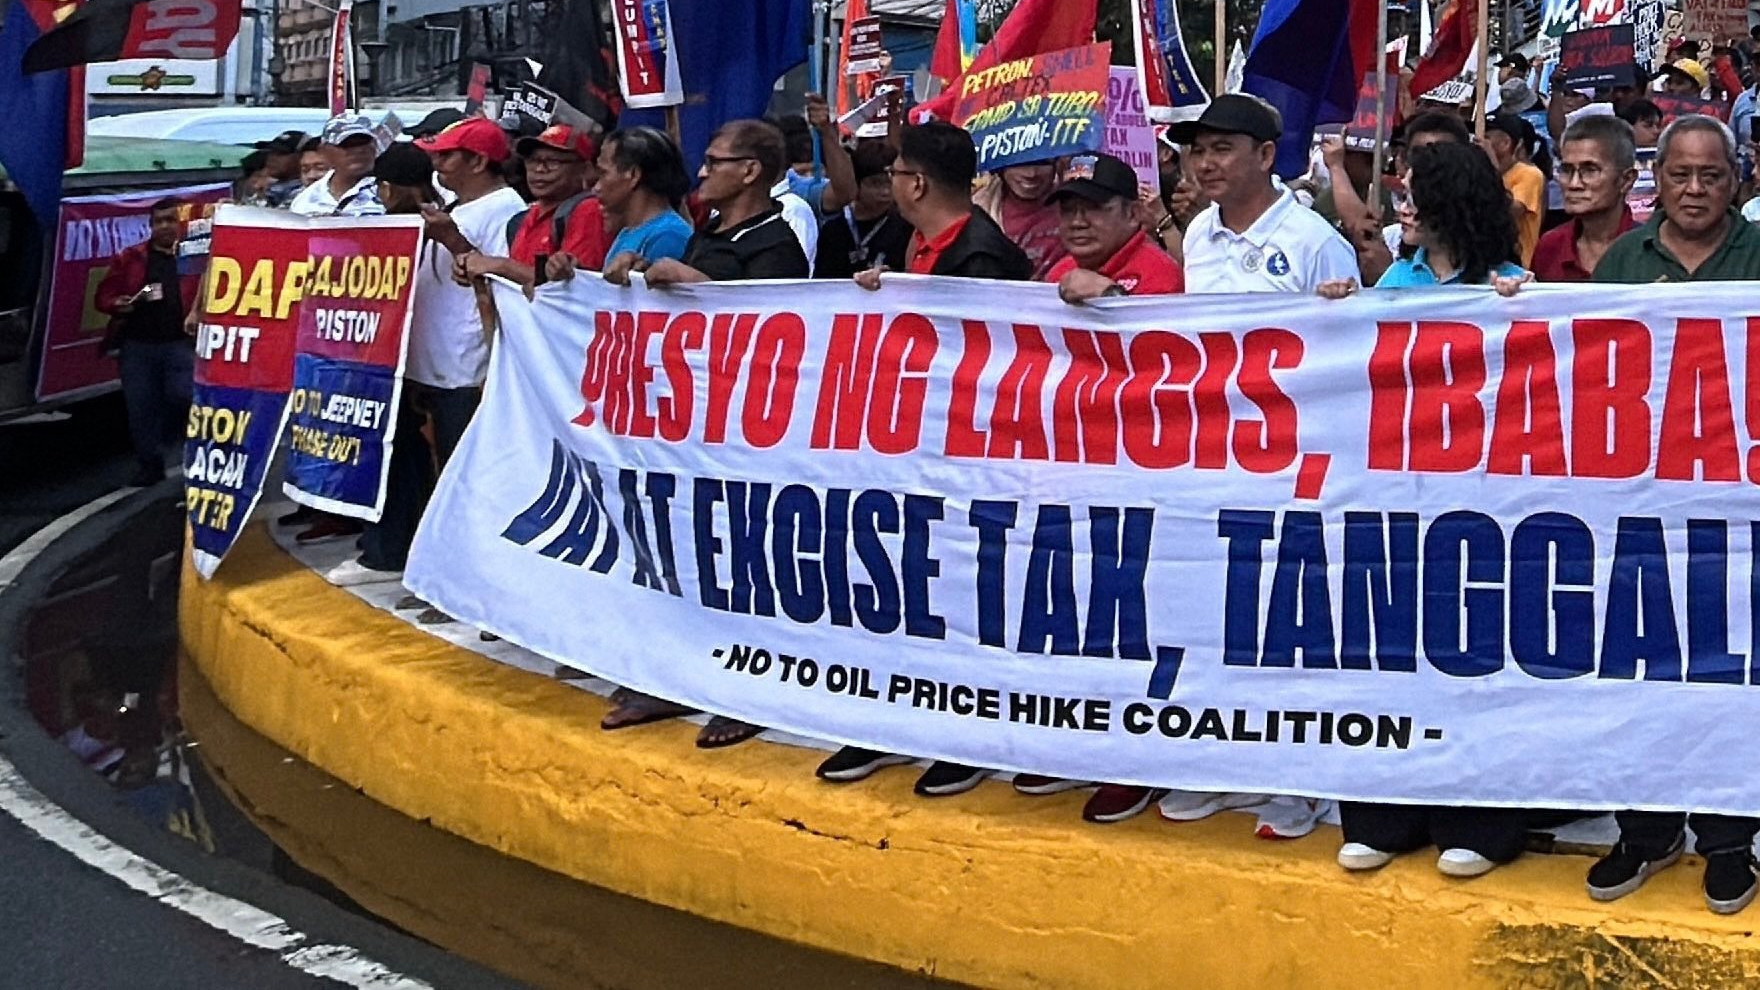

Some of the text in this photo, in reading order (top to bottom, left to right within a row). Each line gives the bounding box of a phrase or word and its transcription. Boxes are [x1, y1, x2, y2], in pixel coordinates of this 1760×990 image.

[1016, 94, 1042, 119] SA
[315, 308, 382, 344] PISTON
[320, 393, 386, 430] JEEPNEY
[809, 311, 940, 456] NG
[943, 318, 1333, 500] LANGIS,
[618, 467, 684, 599] AT
[692, 477, 947, 641] EXCISE
[967, 497, 1187, 701] TAX,
[778, 654, 819, 687] TO
[825, 663, 880, 700] OIL
[887, 673, 1001, 720] PRICE
[1008, 692, 1112, 732] HIKE
